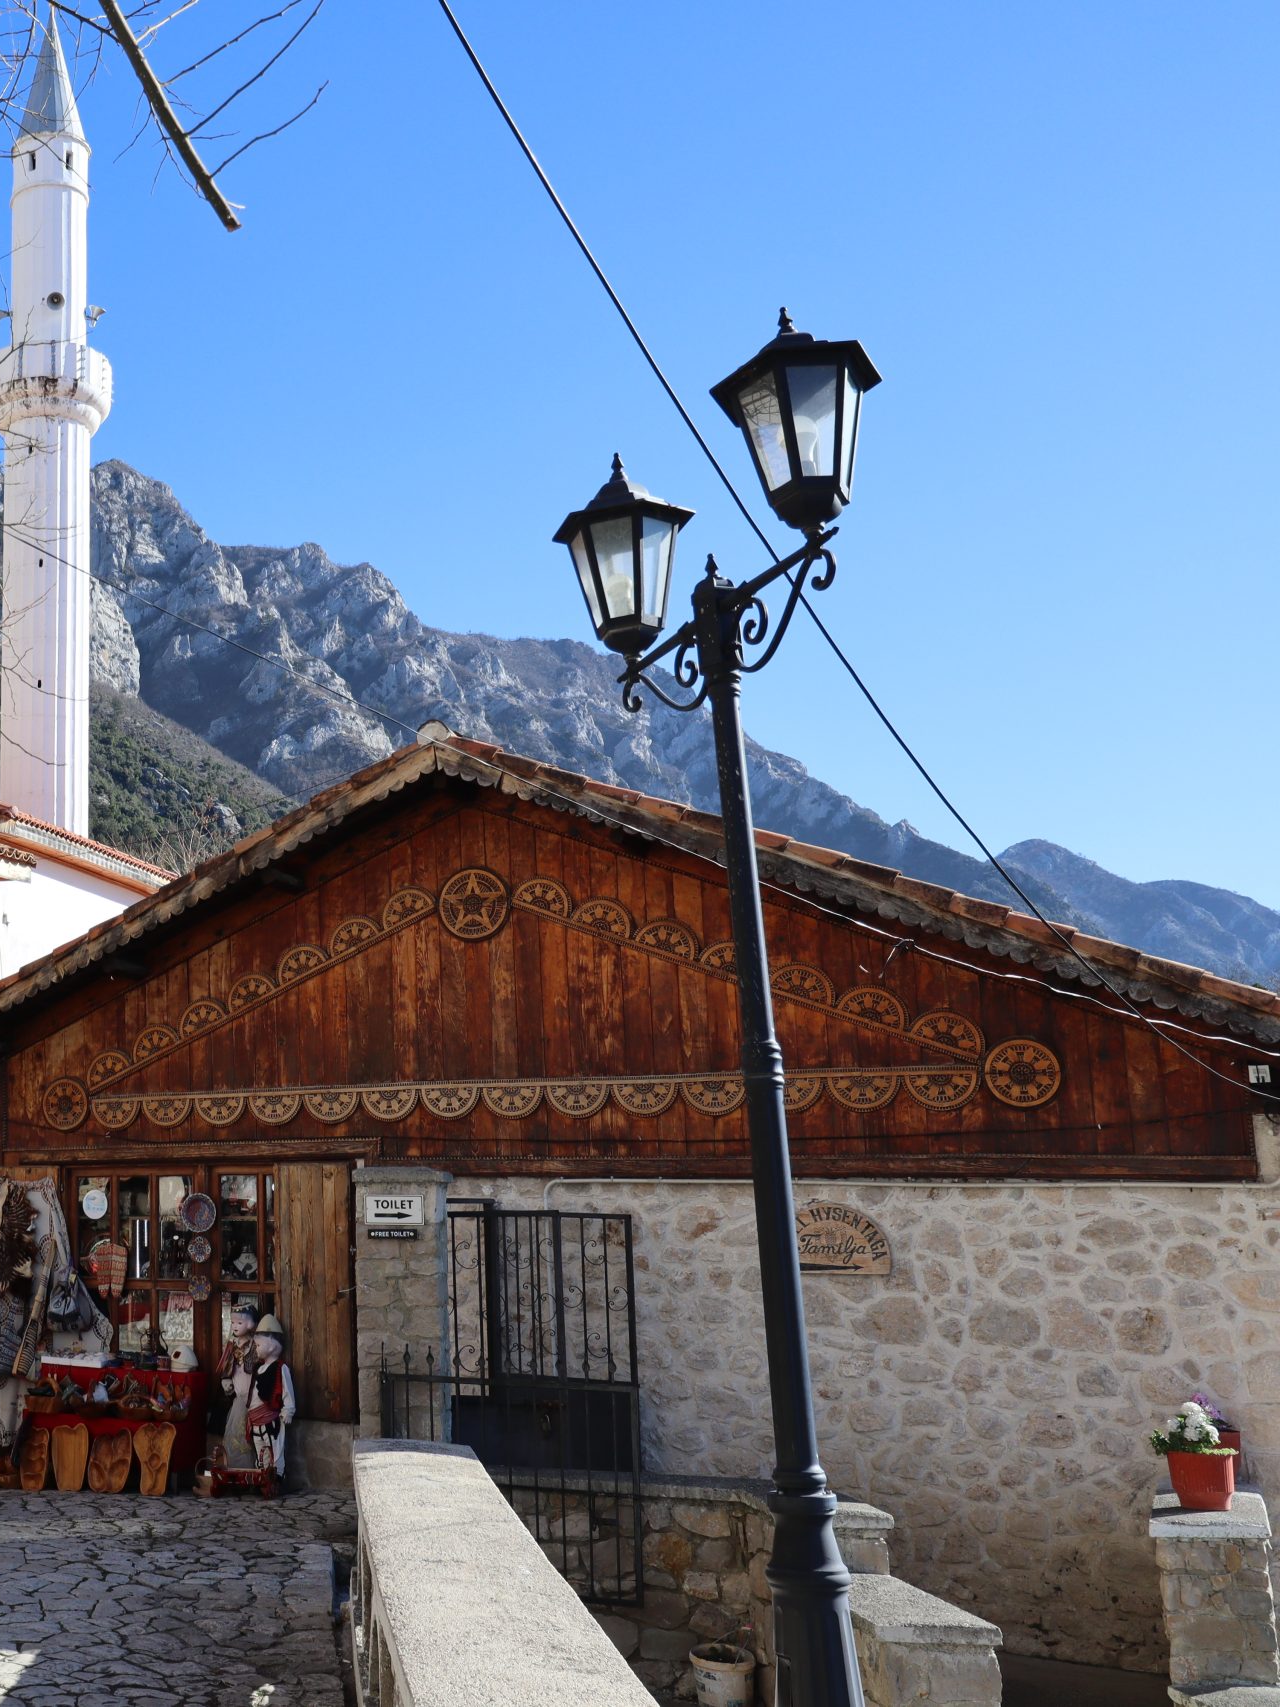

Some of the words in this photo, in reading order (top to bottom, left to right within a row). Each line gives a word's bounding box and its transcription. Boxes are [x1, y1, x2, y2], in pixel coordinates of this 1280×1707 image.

[374, 1199, 414, 1209] TOILET
[799, 1233, 869, 1264] Familja
[809, 1206, 863, 1229] HYSEN
[860, 1220, 888, 1262] TAGA
